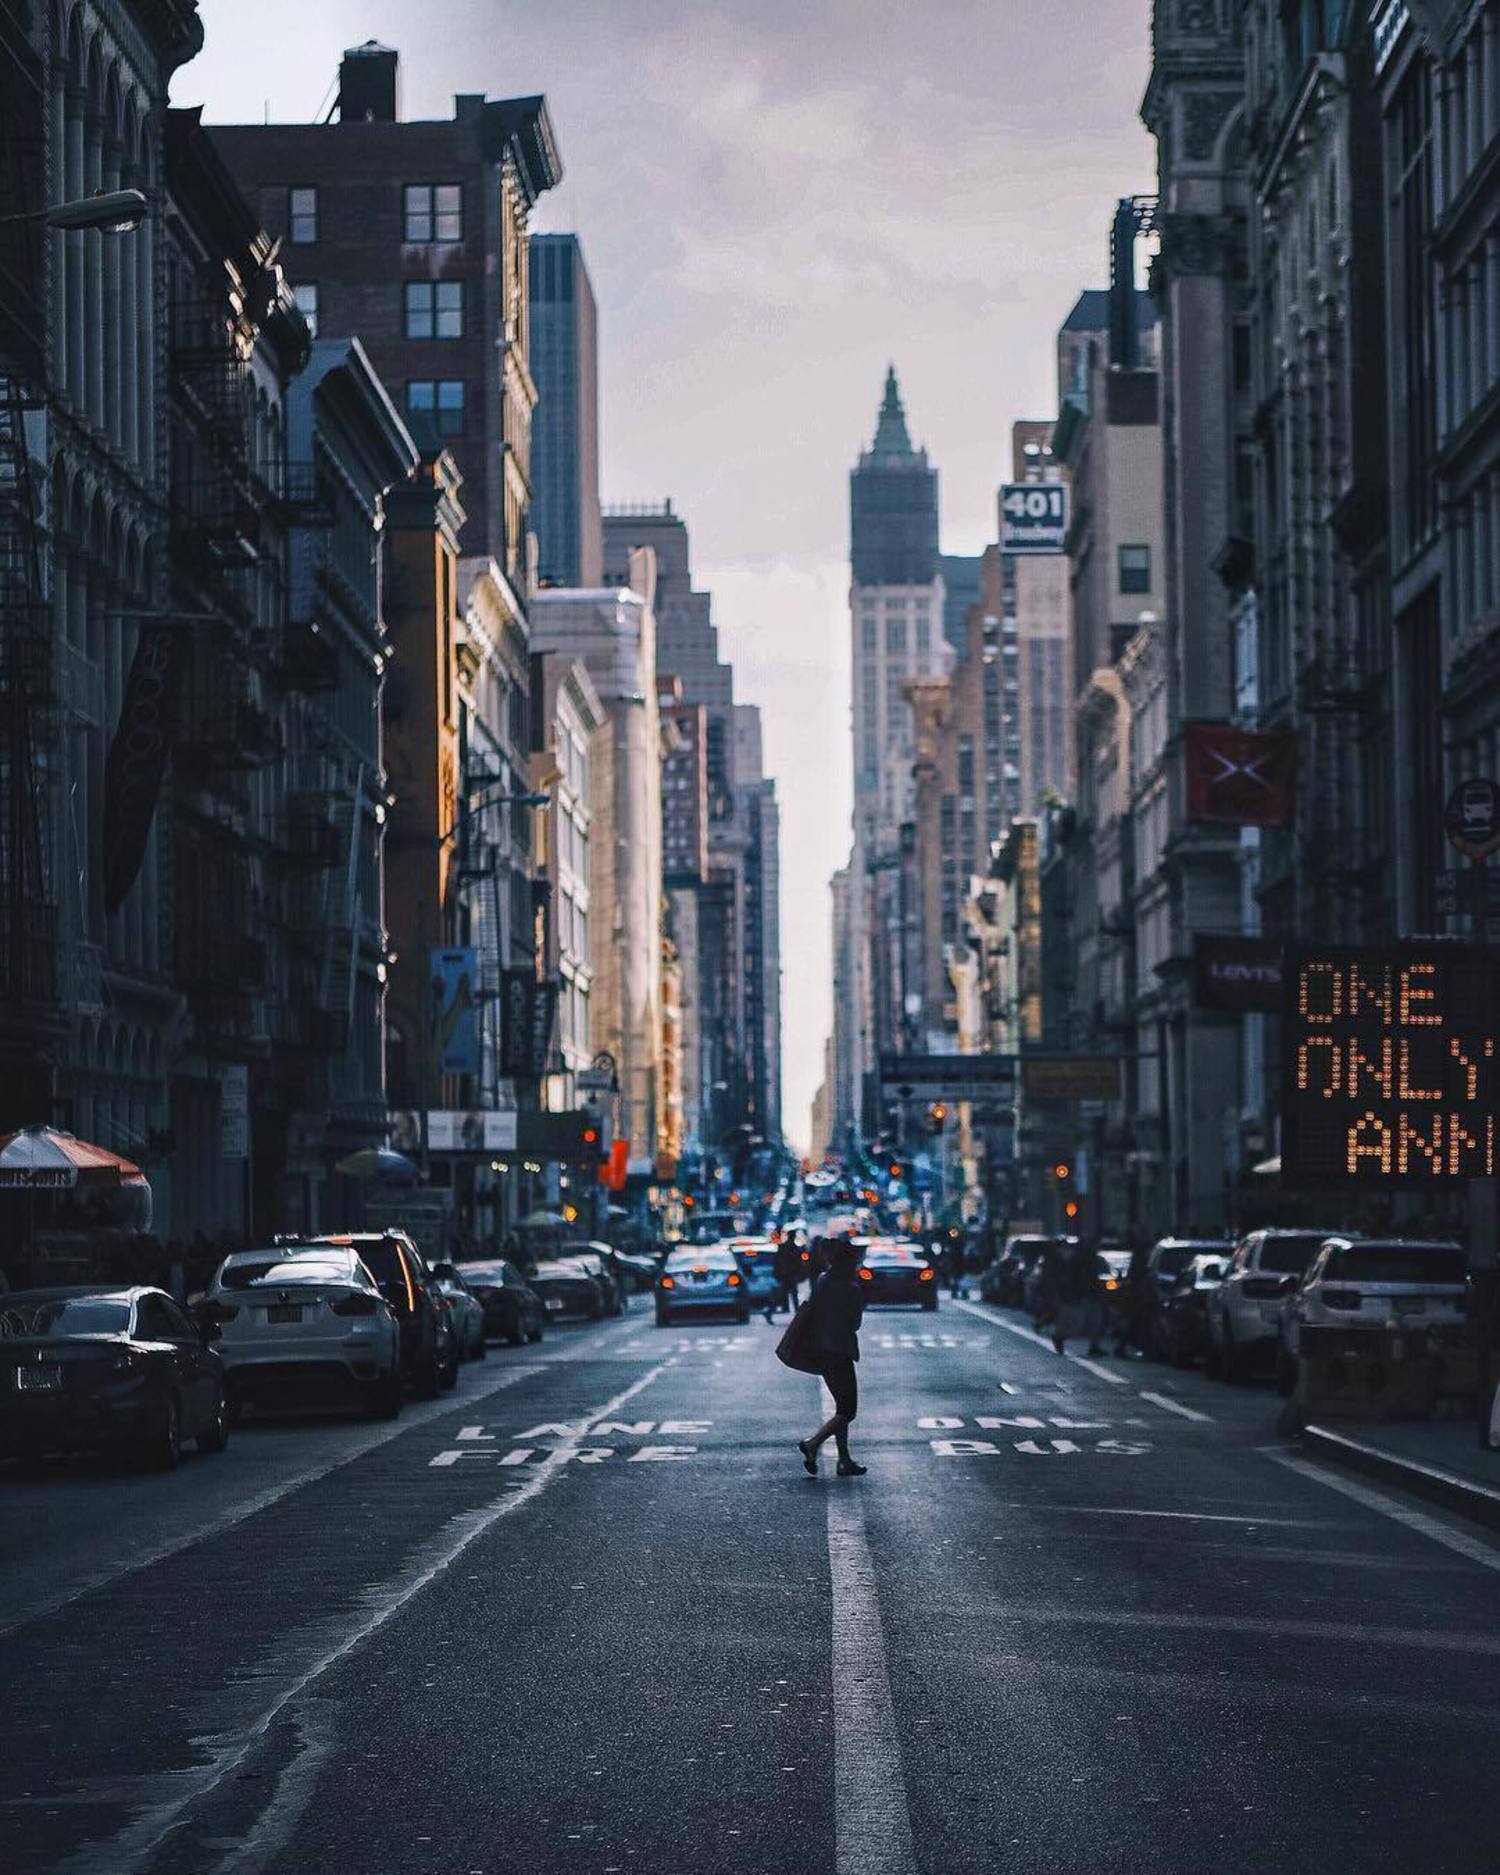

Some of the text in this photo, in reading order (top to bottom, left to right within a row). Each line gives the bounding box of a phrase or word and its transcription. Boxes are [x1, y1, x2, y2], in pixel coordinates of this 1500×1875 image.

[1003, 491, 1061, 518] 401
[1299, 963, 1444, 1025] ONE
[1297, 1036, 1494, 1100] ONLY
[455, 1420, 713, 1440] LANE
[428, 1445, 698, 1467] FIRE
[930, 1439, 1154, 1457] BUS
